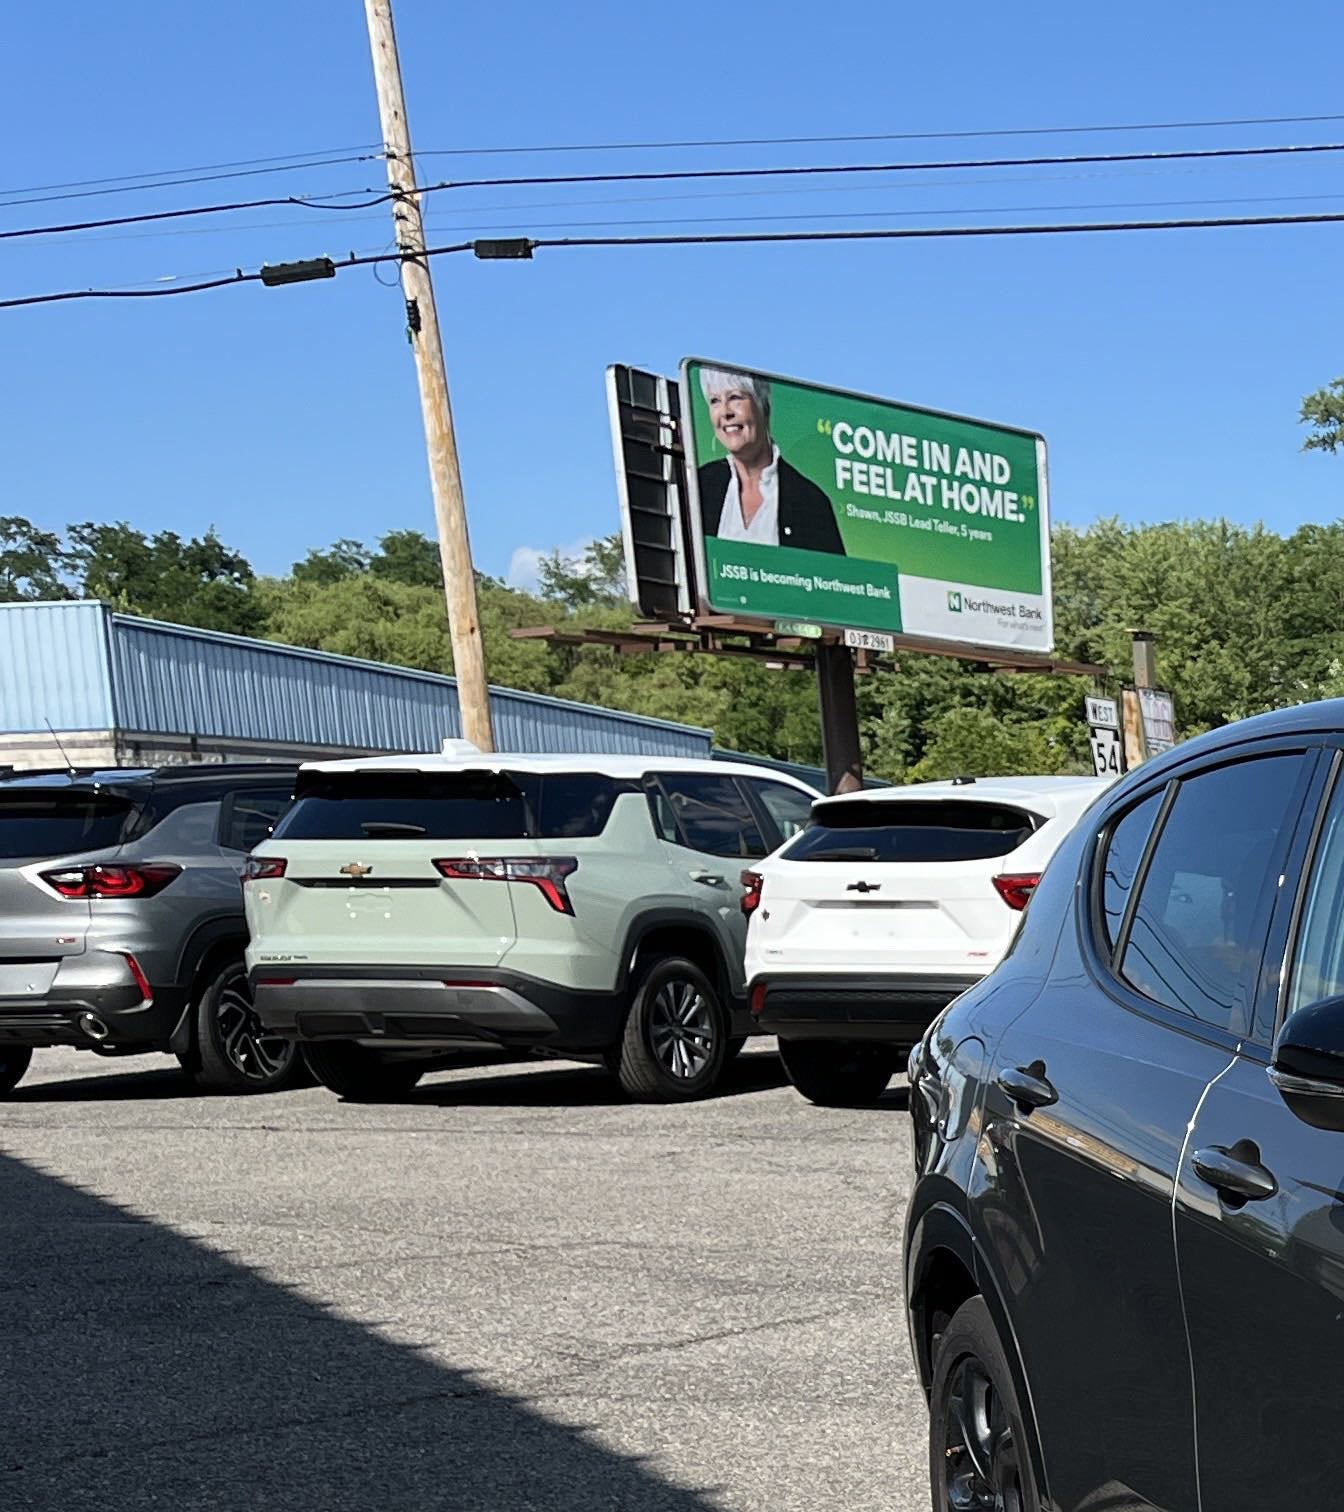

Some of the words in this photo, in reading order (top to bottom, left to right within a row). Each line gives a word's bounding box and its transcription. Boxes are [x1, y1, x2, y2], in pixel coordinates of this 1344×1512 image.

[922, 439, 951, 475] IN
[954, 447, 1011, 486] AND
[835, 458, 902, 500] FEEL
[903, 472, 938, 507] AT
[883, 510, 908, 526] JSSB
[908, 514, 932, 531] Lead
[932, 518, 960, 537] Teller,
[960, 524, 968, 537] 5
[968, 528, 993, 541] years
[720, 564, 748, 580] JSSB
[749, 567, 759, 582] is
[760, 569, 813, 592] becoming
[813, 576, 865, 595] Northwest
[866, 583, 891, 599] Bank
[964, 597, 1016, 617] Northwest
[1019, 604, 1042, 620] Bank
[1090, 703, 1113, 722] WEST
[1096, 743, 1119, 774] 54
